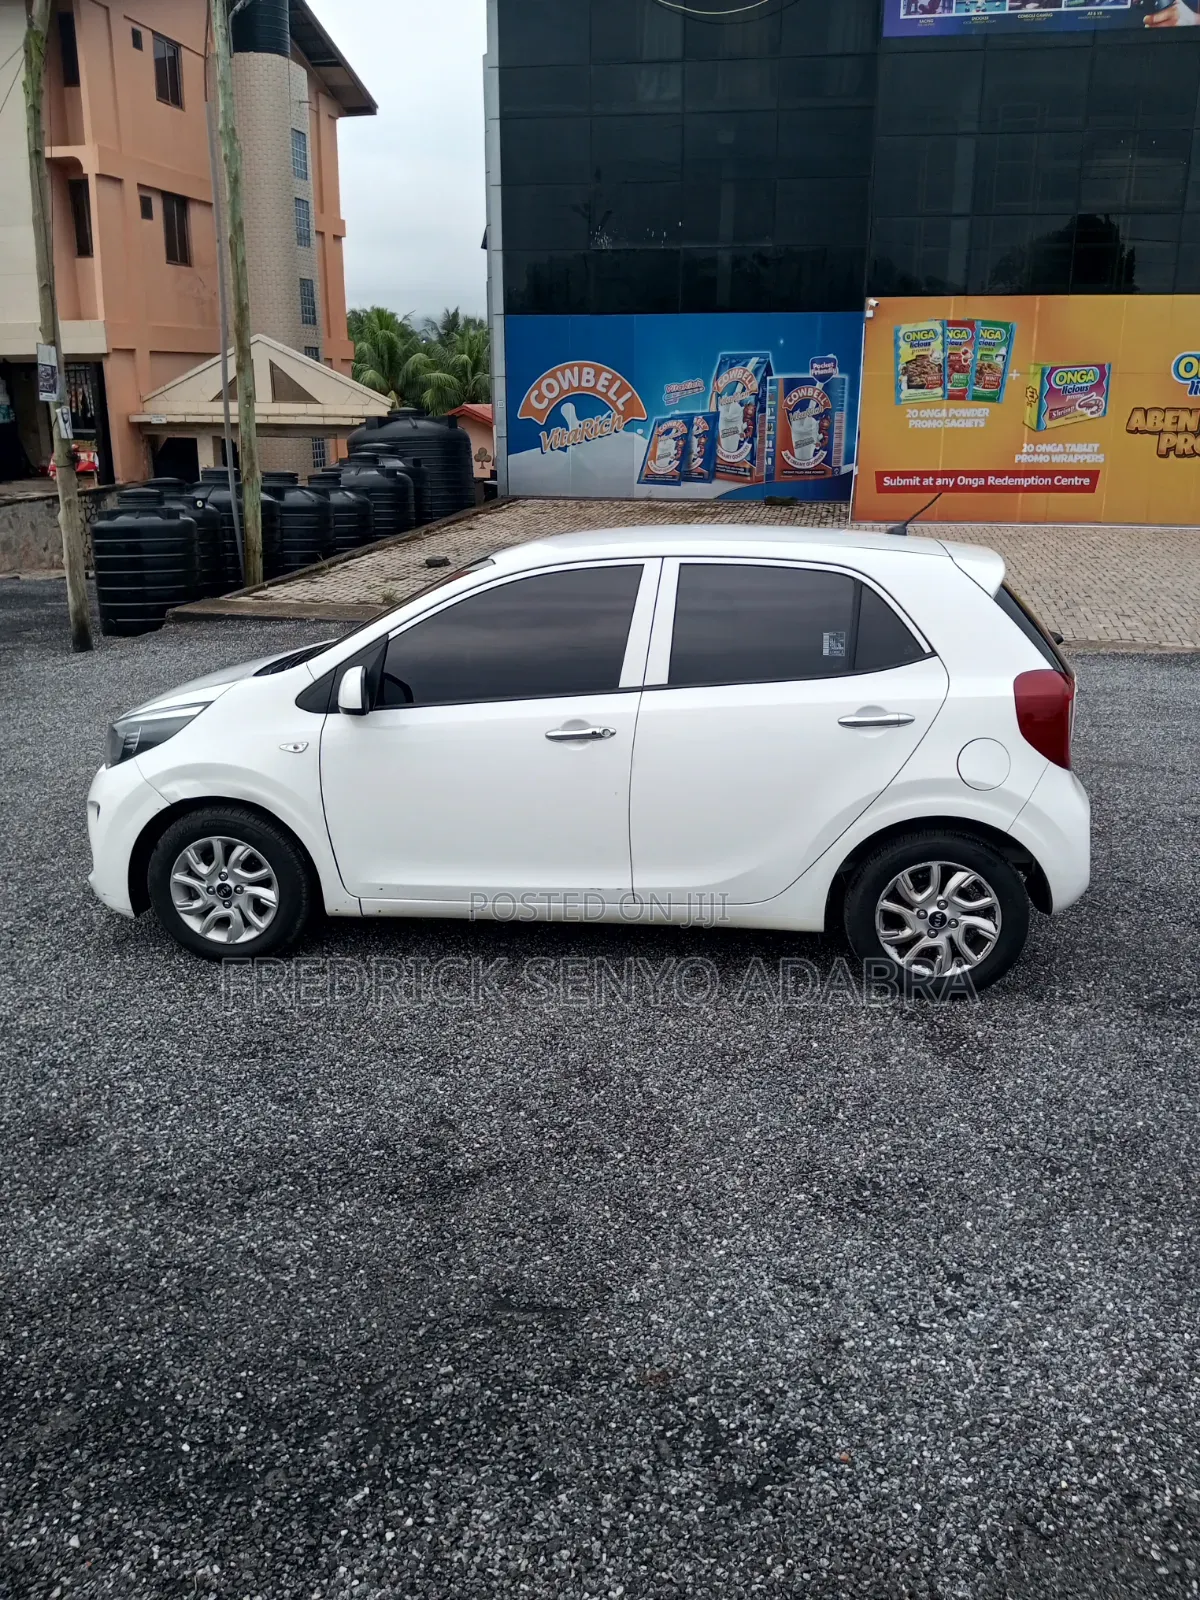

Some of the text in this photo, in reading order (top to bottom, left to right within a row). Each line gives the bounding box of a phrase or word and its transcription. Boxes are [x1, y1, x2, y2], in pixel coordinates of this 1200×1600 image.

[904, 329, 936, 341] ONGA
[947, 329, 968, 340] NGA
[980, 329, 1001, 340] NGA
[910, 340, 931, 349] licious
[718, 368, 756, 390] COWBELL
[1055, 369, 1096, 386] ONGA
[530, 366, 632, 411] COWBELL
[1062, 384, 1090, 395] licious
[787, 387, 828, 405] COWBELL
[906, 408, 989, 418] 20 ONGA POWDER
[1052, 405, 1075, 417] Shrimp
[908, 419, 985, 428] PROMO SACHETS
[539, 411, 625, 453] VitaRich
[1021, 443, 1099, 453] 20 ONGA TABLET
[1014, 453, 1104, 463] PROMO WRAPPERS
[883, 475, 1090, 489] Submit at any Onga Redemption Centre
